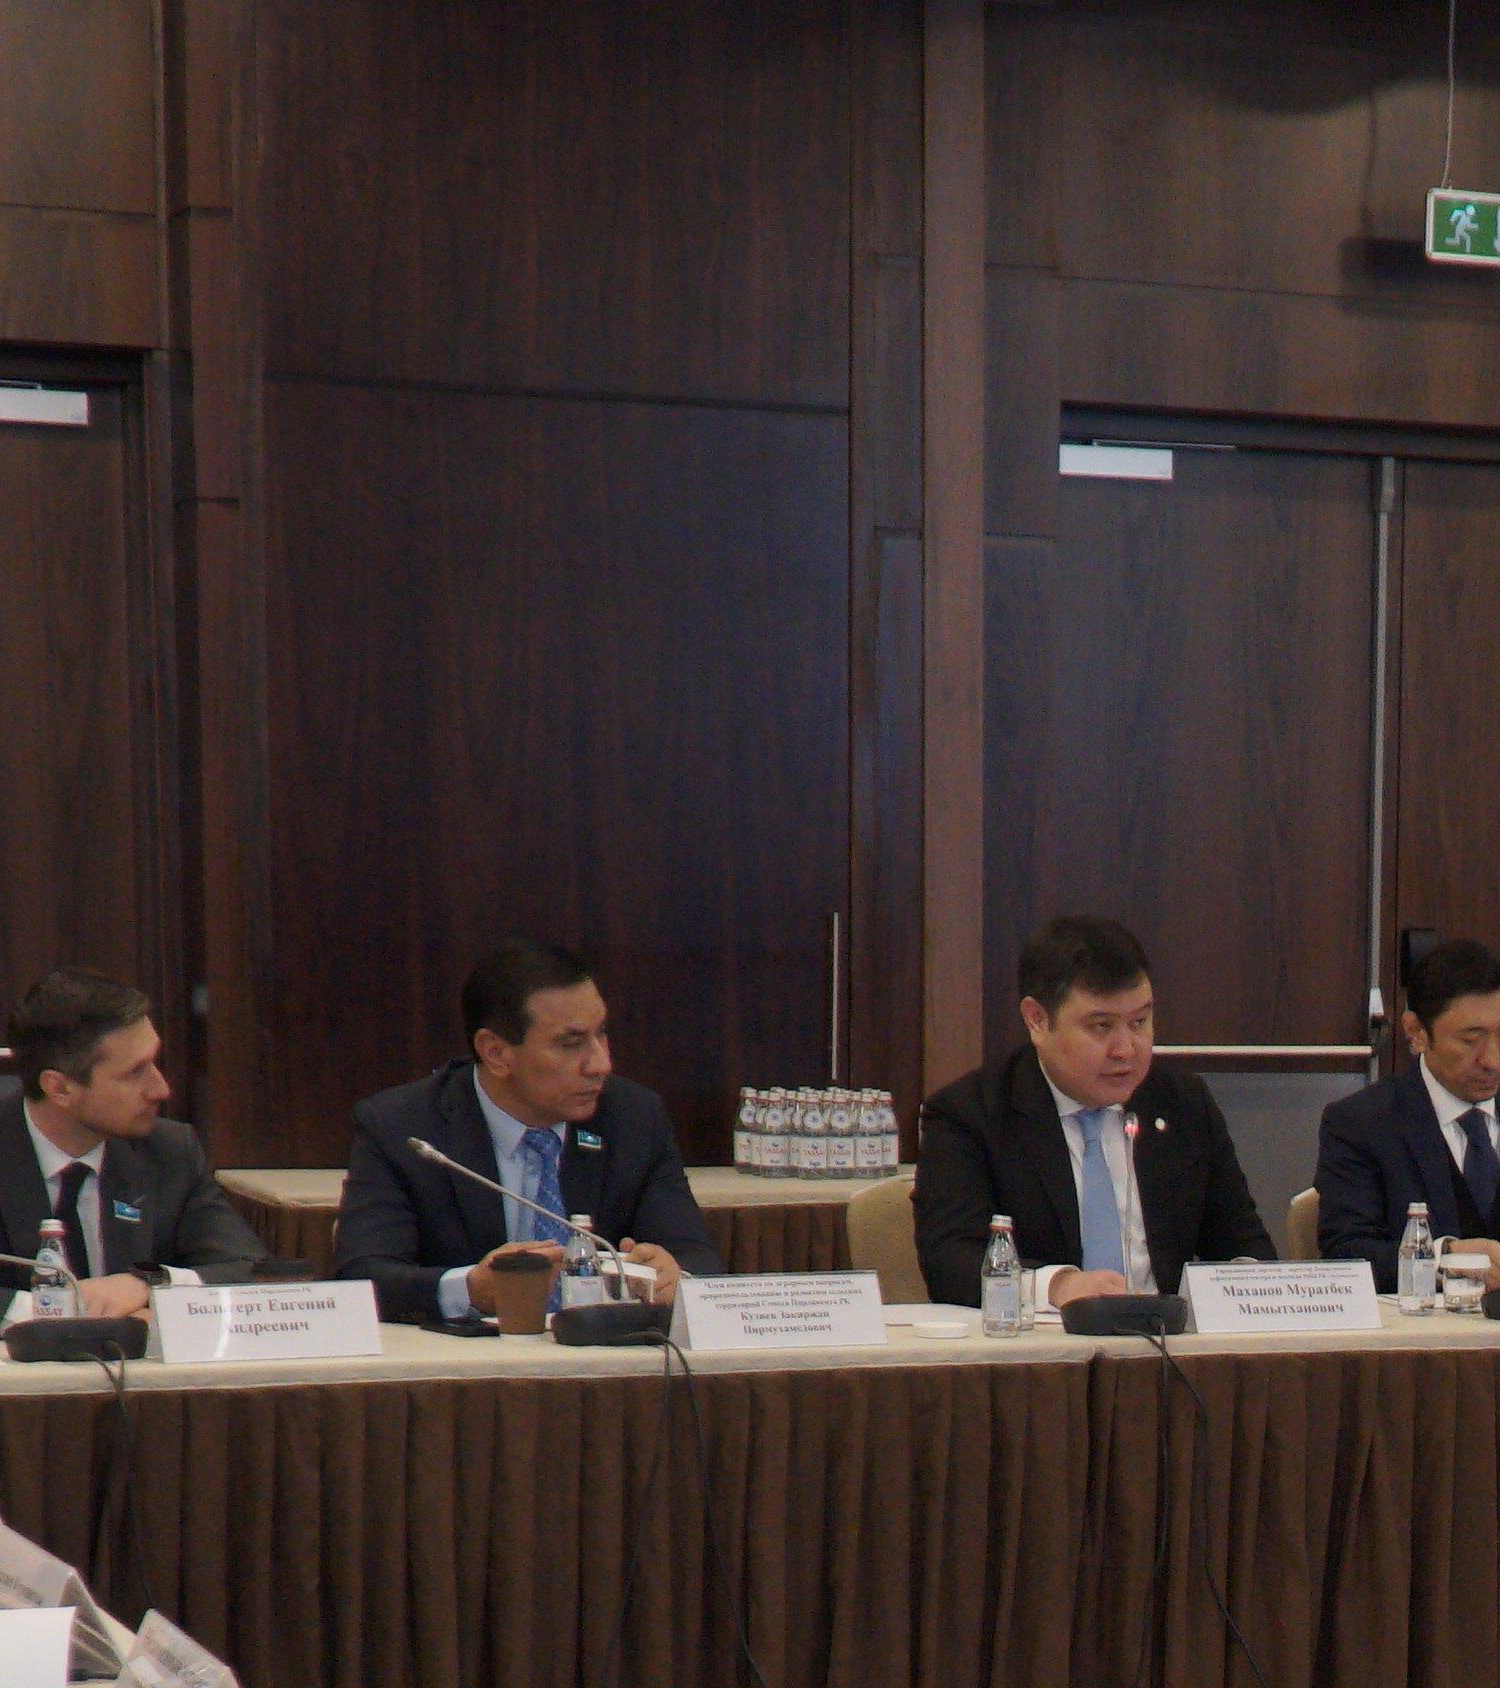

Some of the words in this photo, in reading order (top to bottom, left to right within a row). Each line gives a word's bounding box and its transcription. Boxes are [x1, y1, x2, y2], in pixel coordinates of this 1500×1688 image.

[1222, 1284, 1283, 1298] Маханов
[1287, 1283, 1354, 1298] Муратбек
[269, 1296, 337, 1312] Евгений
[1238, 1303, 1344, 1316] Мамытханович
